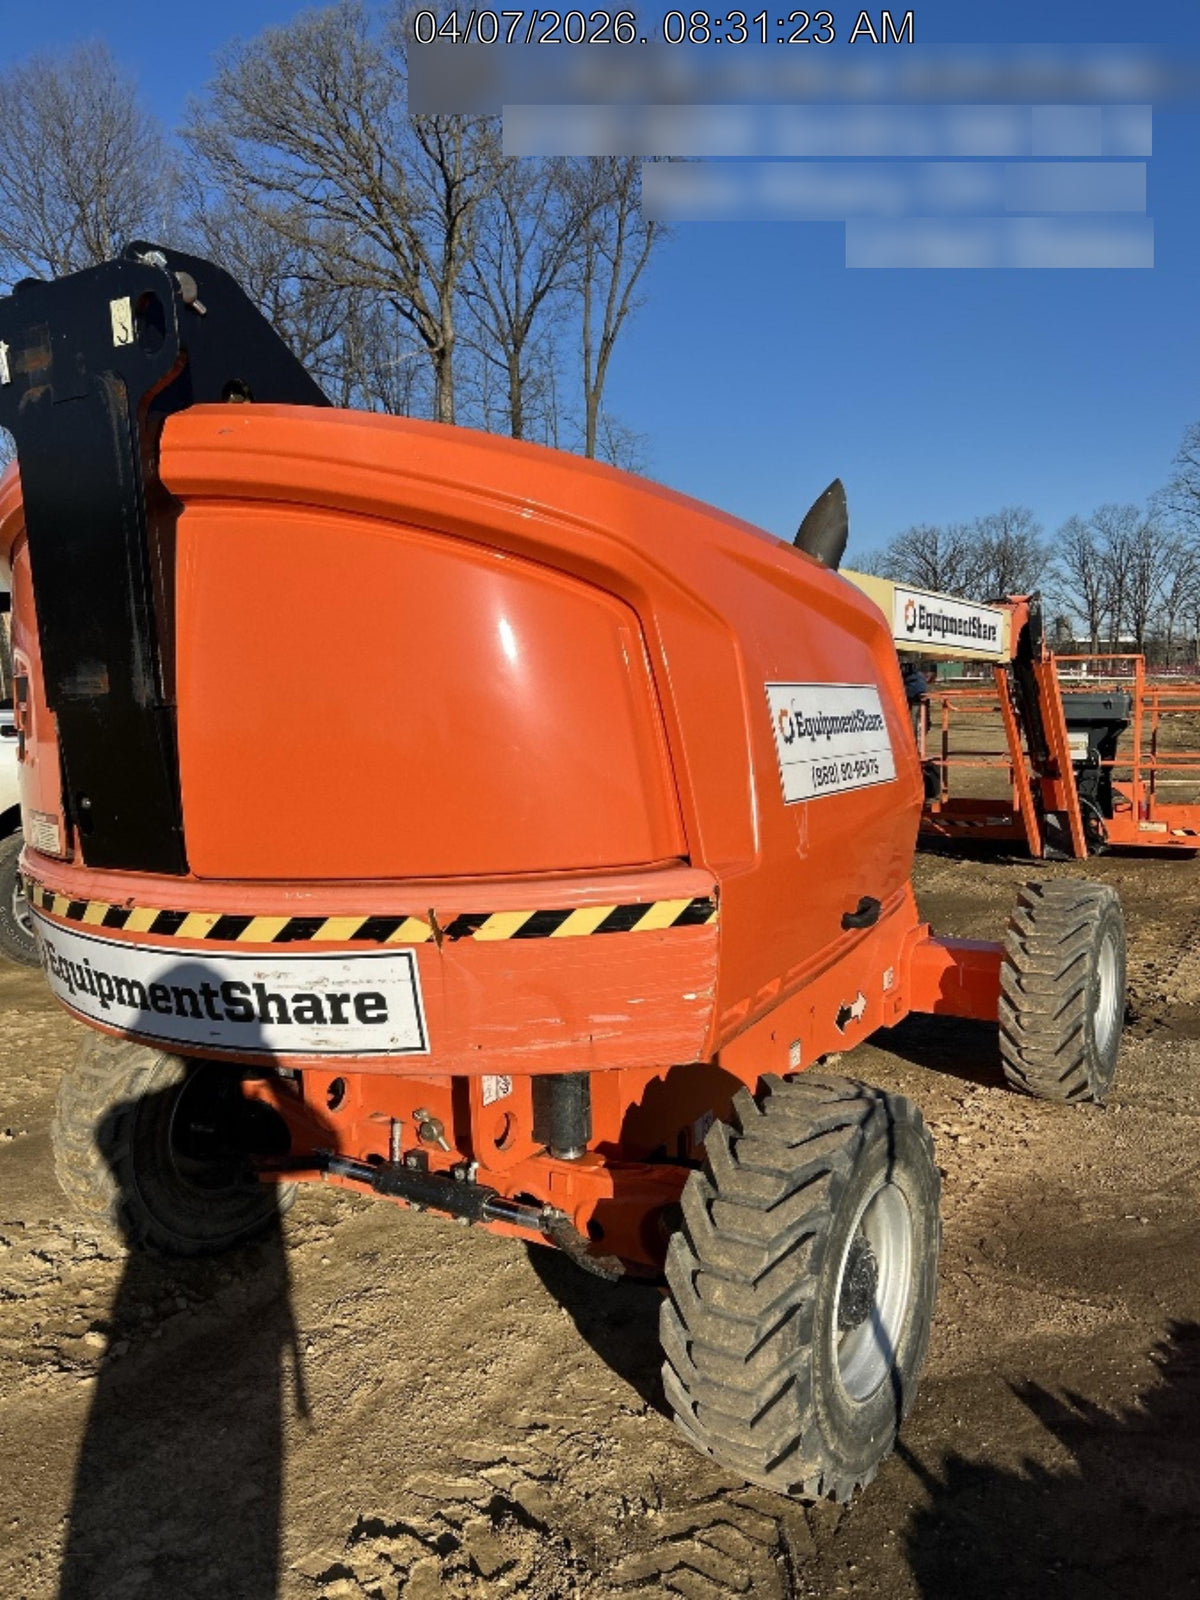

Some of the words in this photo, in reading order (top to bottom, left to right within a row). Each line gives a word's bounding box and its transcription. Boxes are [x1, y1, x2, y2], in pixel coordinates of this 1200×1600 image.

[918, 604, 997, 641] EquipmentShare
[794, 708, 884, 742] EquipmentShare
[44, 938, 389, 1025] EquipmentShare
